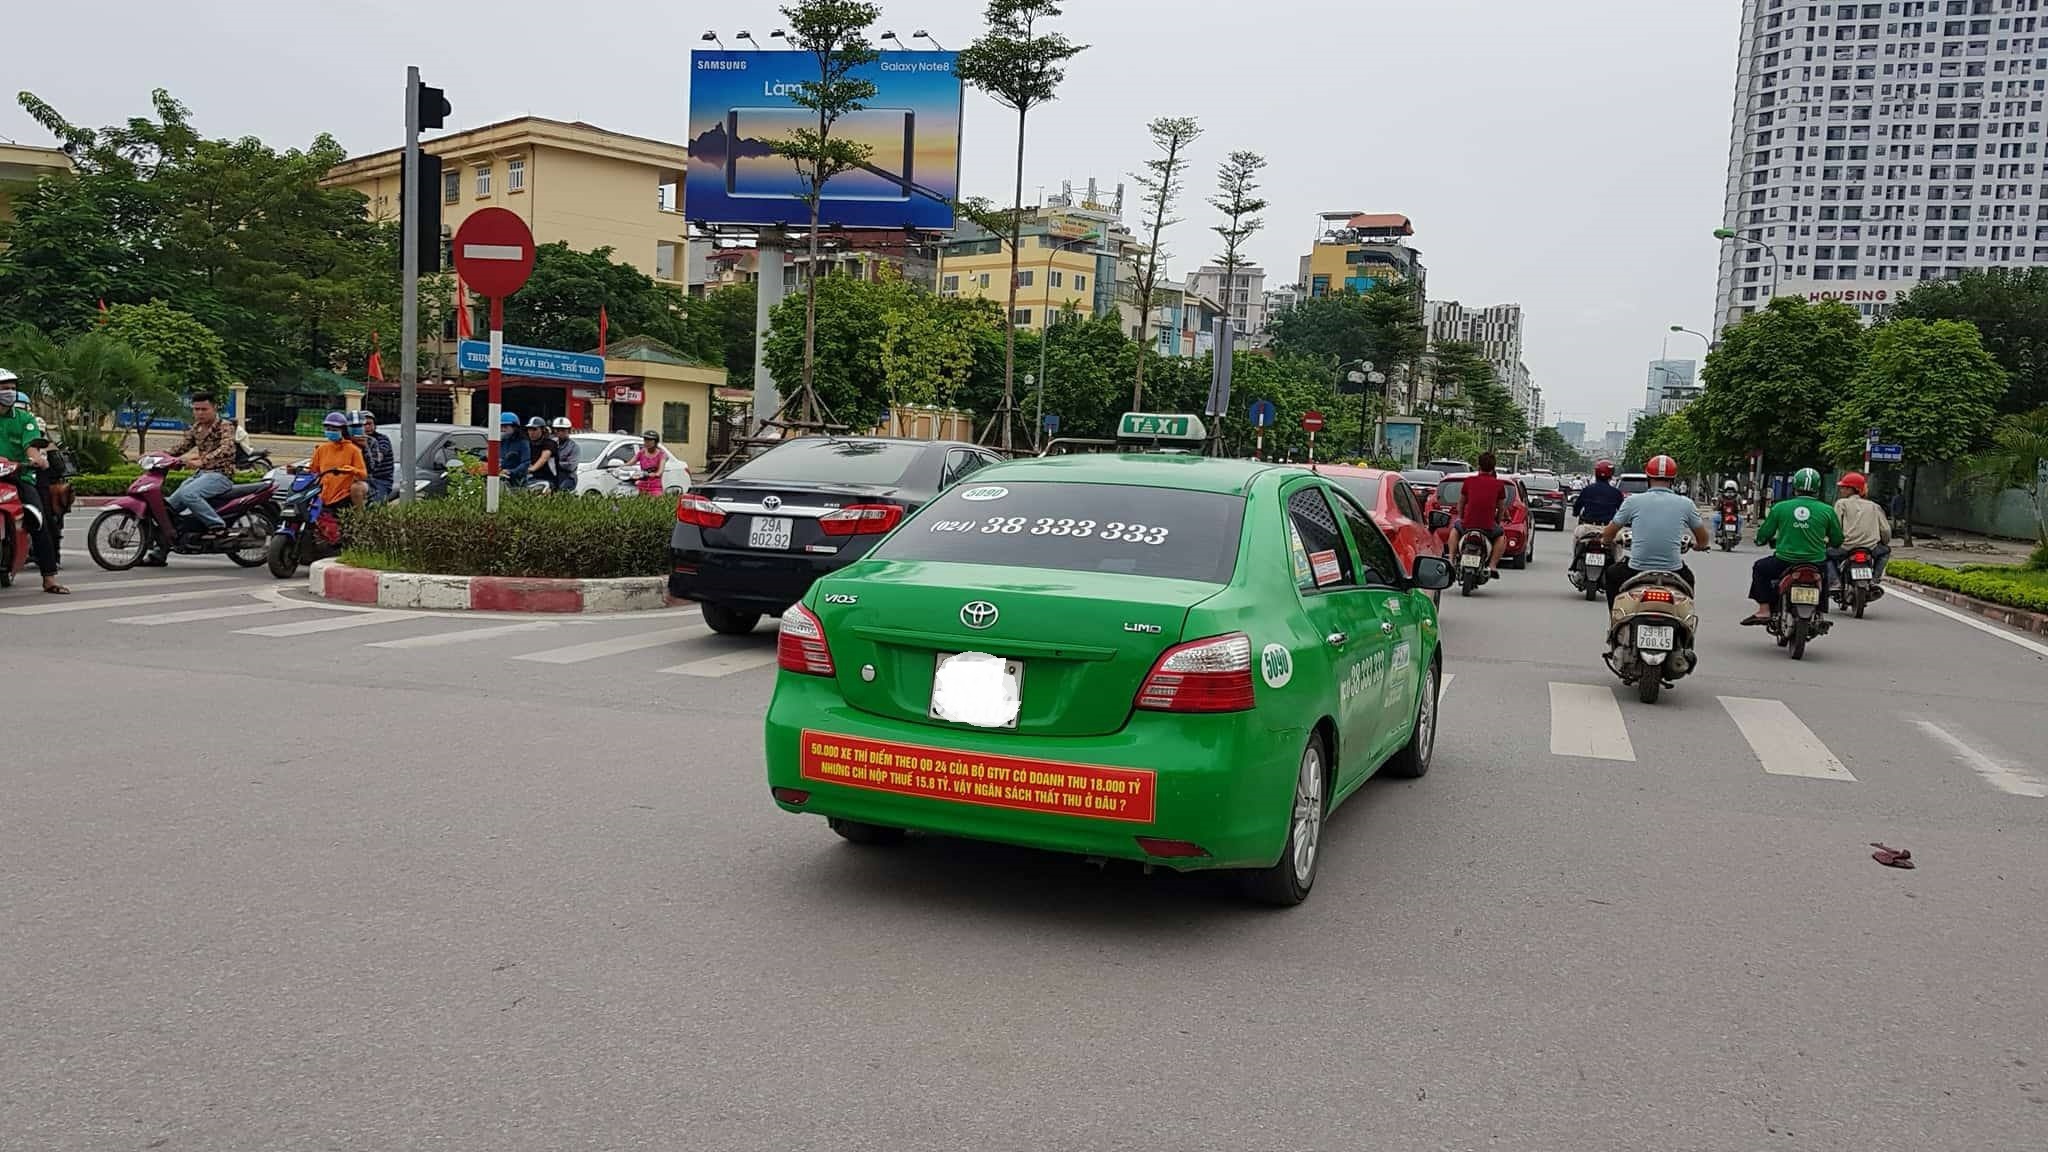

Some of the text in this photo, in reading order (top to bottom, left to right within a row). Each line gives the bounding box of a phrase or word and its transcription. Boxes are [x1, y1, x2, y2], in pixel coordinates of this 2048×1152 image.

[697, 60, 748, 70] SAMSUNG
[880, 62, 950, 74] Galaxy Note8
[1809, 289, 1888, 302] HOUSING
[579, 364, 600, 375] THAO
[966, 488, 1004, 498] 5090
[760, 518, 782, 533] 29A
[980, 516, 1027, 535] 38
[1030, 517, 1097, 537] 333
[1100, 521, 1169, 545] 333
[751, 533, 789, 548] 802.92
[825, 593, 858, 604] VIOS
[1124, 622, 1162, 634] LIMO
[1264, 647, 1289, 681] 5090
[811, 742, 839, 758] 50.000
[840, 747, 853, 760] XE
[895, 754, 918, 770] THEO
[935, 760, 947, 774] 24
[949, 759, 969, 776] CỦA
[987, 766, 1011, 781] GTVT
[1013, 767, 1027, 783] CÓ
[1029, 770, 1065, 788] DOANH
[1067, 775, 1088, 790] THU
[1091, 778, 1126, 794] 18.000
[1128, 777, 1142, 795] TỶ
[889, 770, 914, 787] THUẾ
[916, 775, 936, 790] 15.8
[953, 779, 972, 796] VẬY
[974, 782, 1003, 798] NGÂN
[1004, 785, 1033, 802] SÁCH
[1034, 787, 1060, 805] THẤT
[1062, 792, 1082, 808] THU
[1119, 799, 1127, 812] ?
